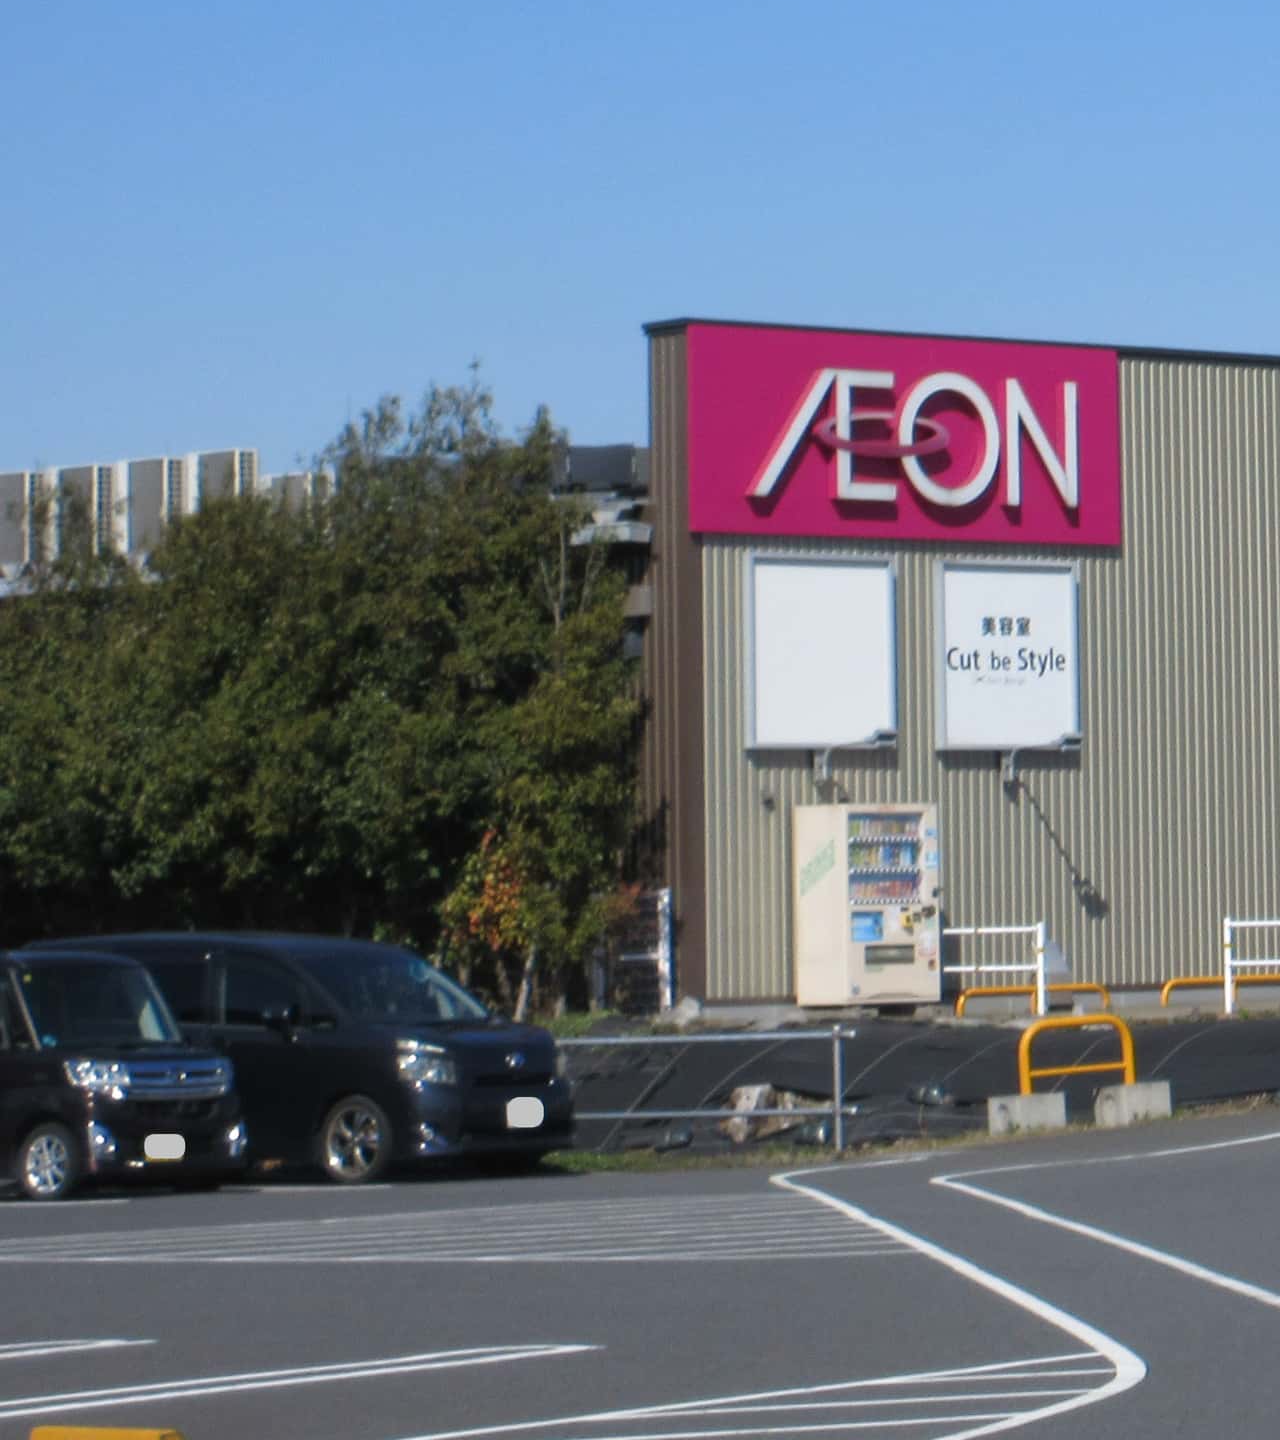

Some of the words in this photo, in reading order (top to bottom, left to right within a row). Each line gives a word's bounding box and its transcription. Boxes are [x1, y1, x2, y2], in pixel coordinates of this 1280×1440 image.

[947, 646, 981, 671] Cut
[990, 650, 1011, 671] be
[1018, 647, 1066, 678] Style
